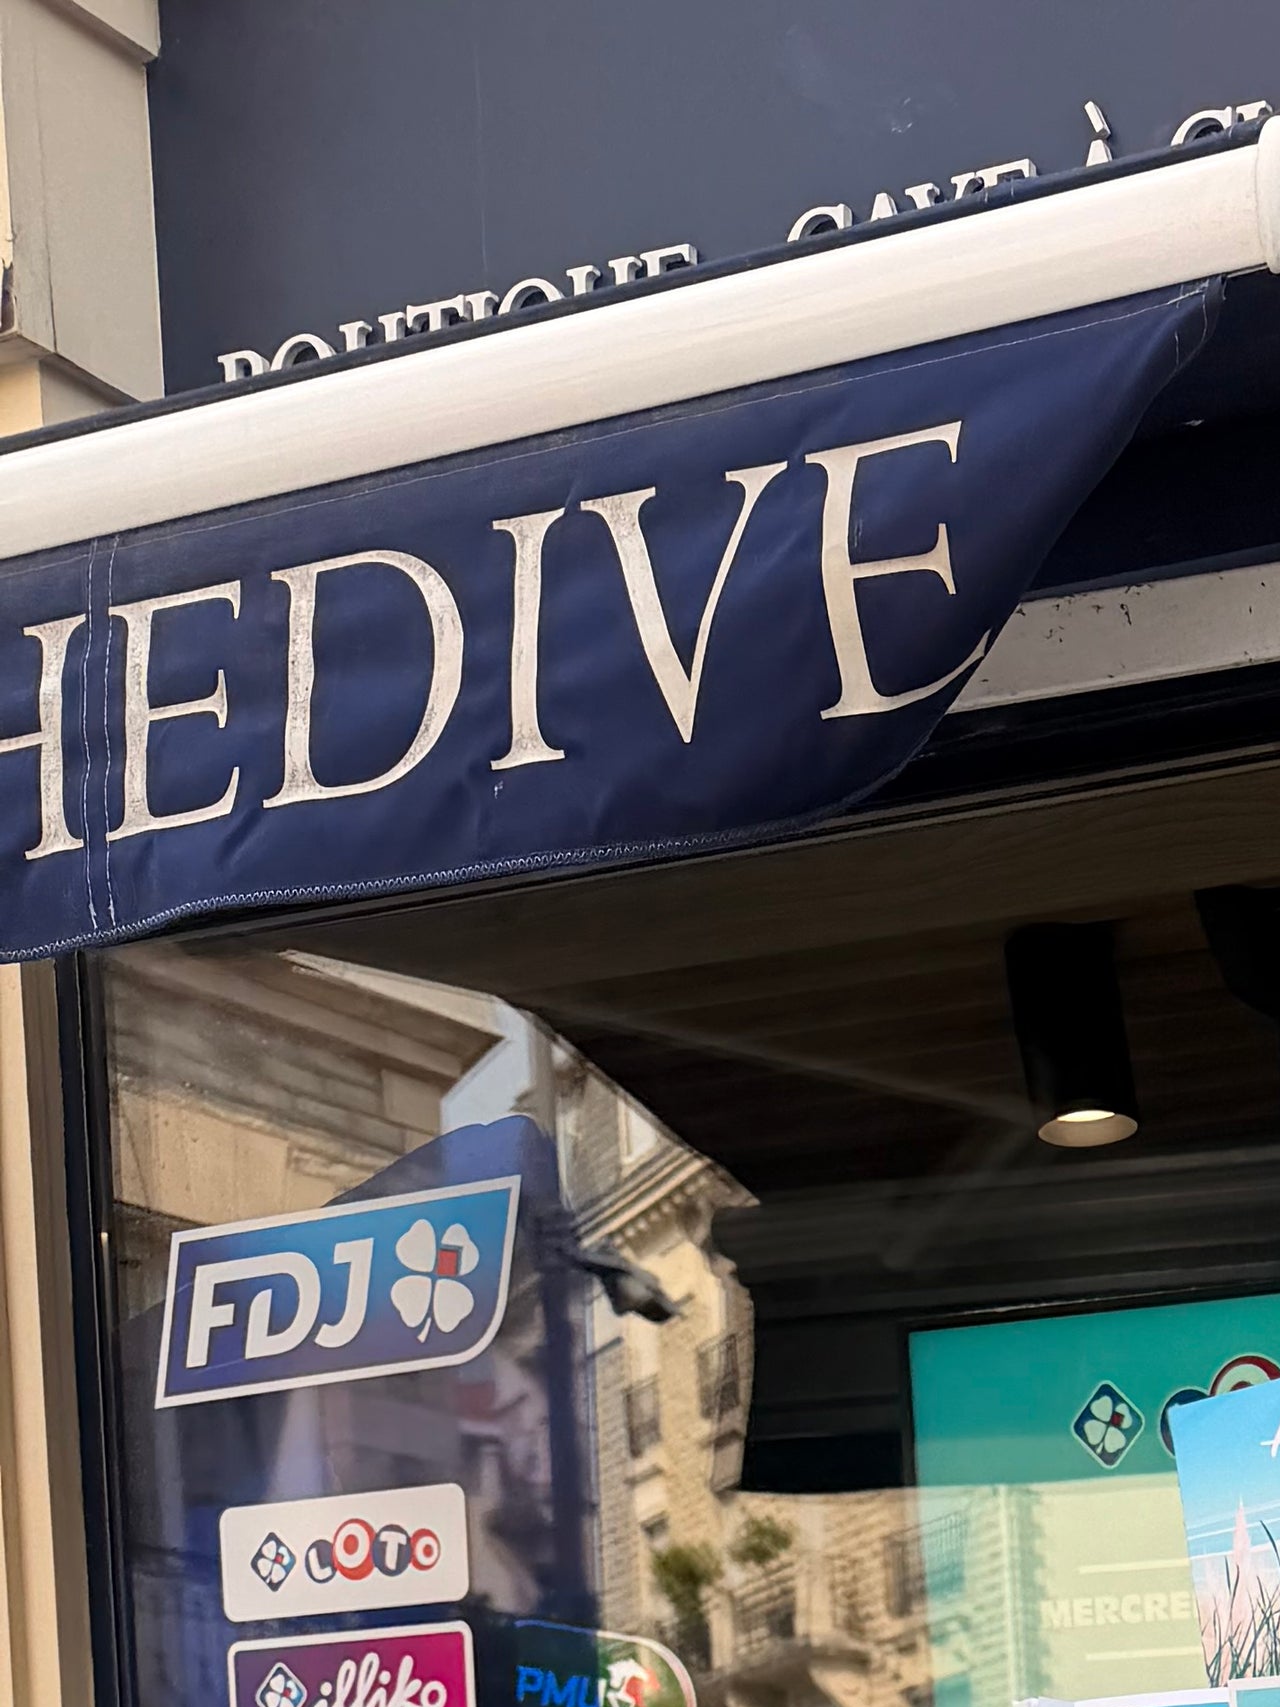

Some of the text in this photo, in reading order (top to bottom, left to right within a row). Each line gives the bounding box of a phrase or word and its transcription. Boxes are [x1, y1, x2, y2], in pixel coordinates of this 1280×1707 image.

[186, 1237, 375, 1369] FDJ
[304, 1518, 441, 1584] LOTO
[1040, 1591, 1197, 1629] MERCRE
